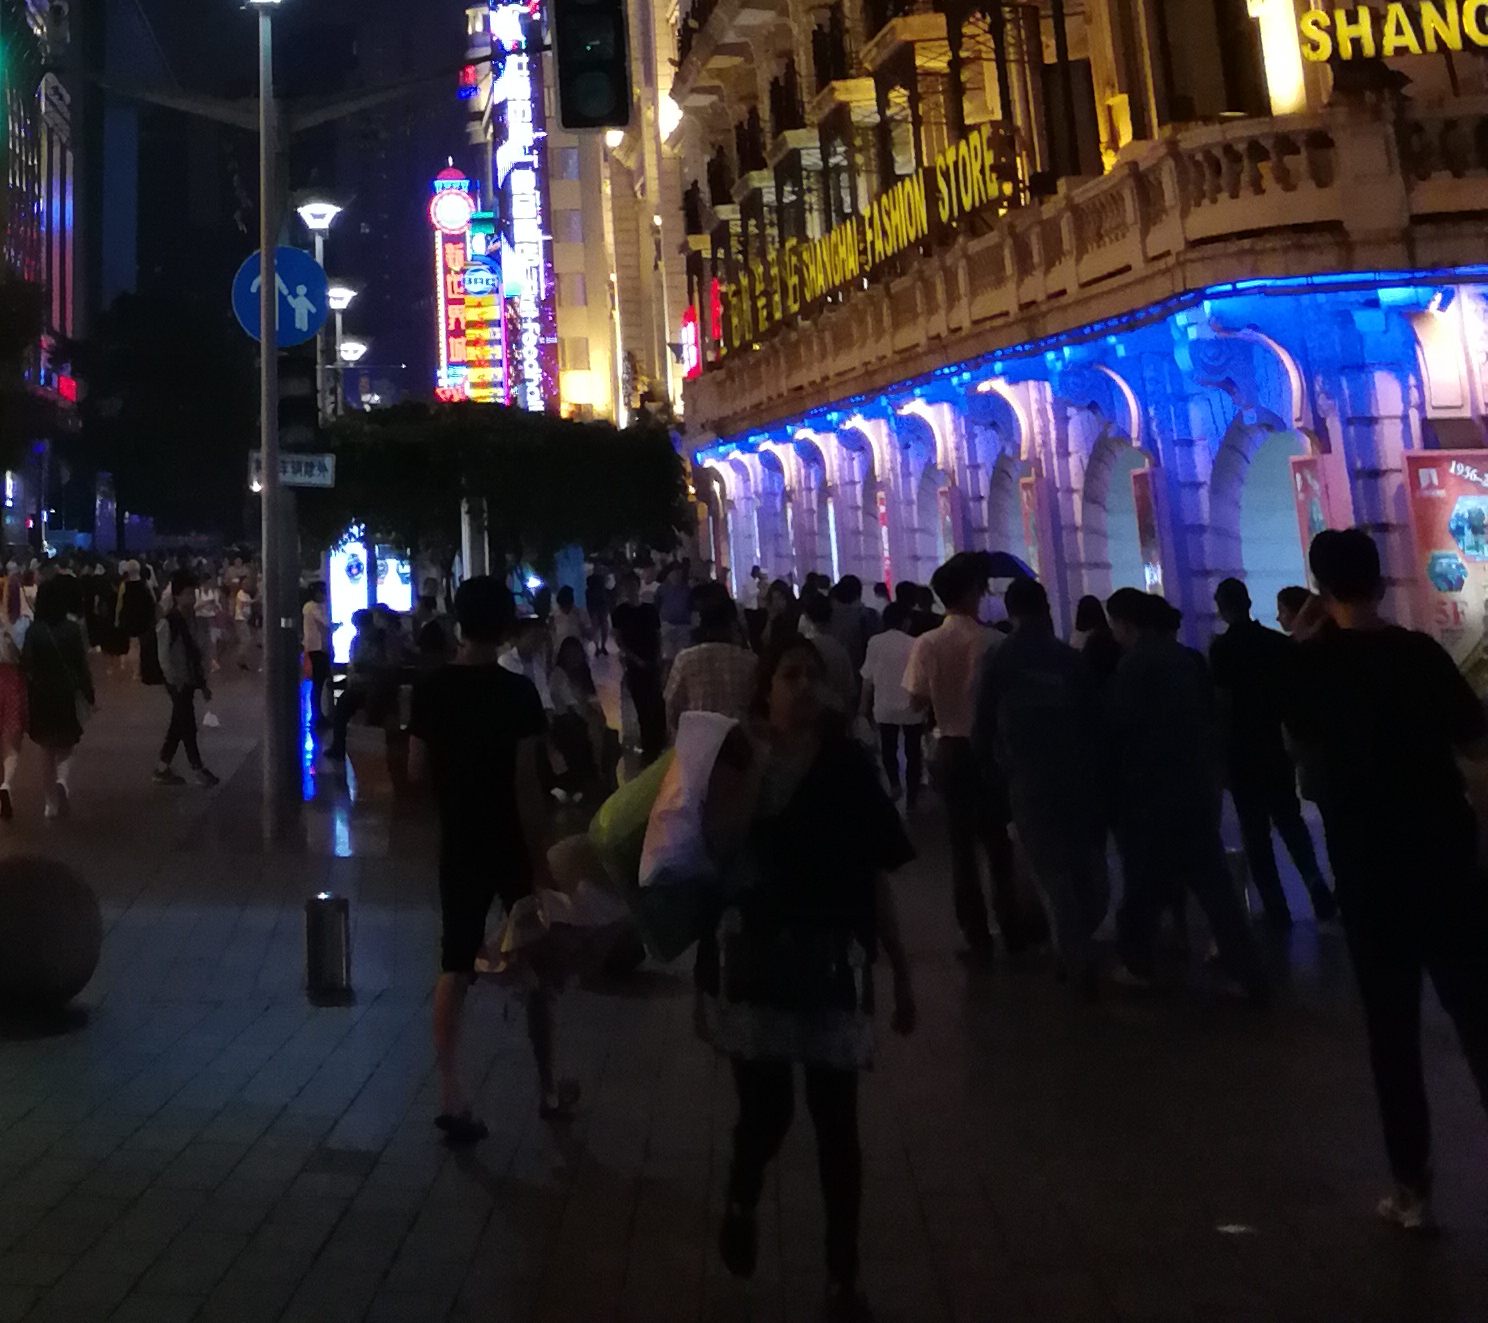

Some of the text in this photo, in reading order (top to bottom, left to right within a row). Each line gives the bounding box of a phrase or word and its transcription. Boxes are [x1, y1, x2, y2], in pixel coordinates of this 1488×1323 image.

[801, 122, 1000, 303] SHANGHAI FASHION STORE
